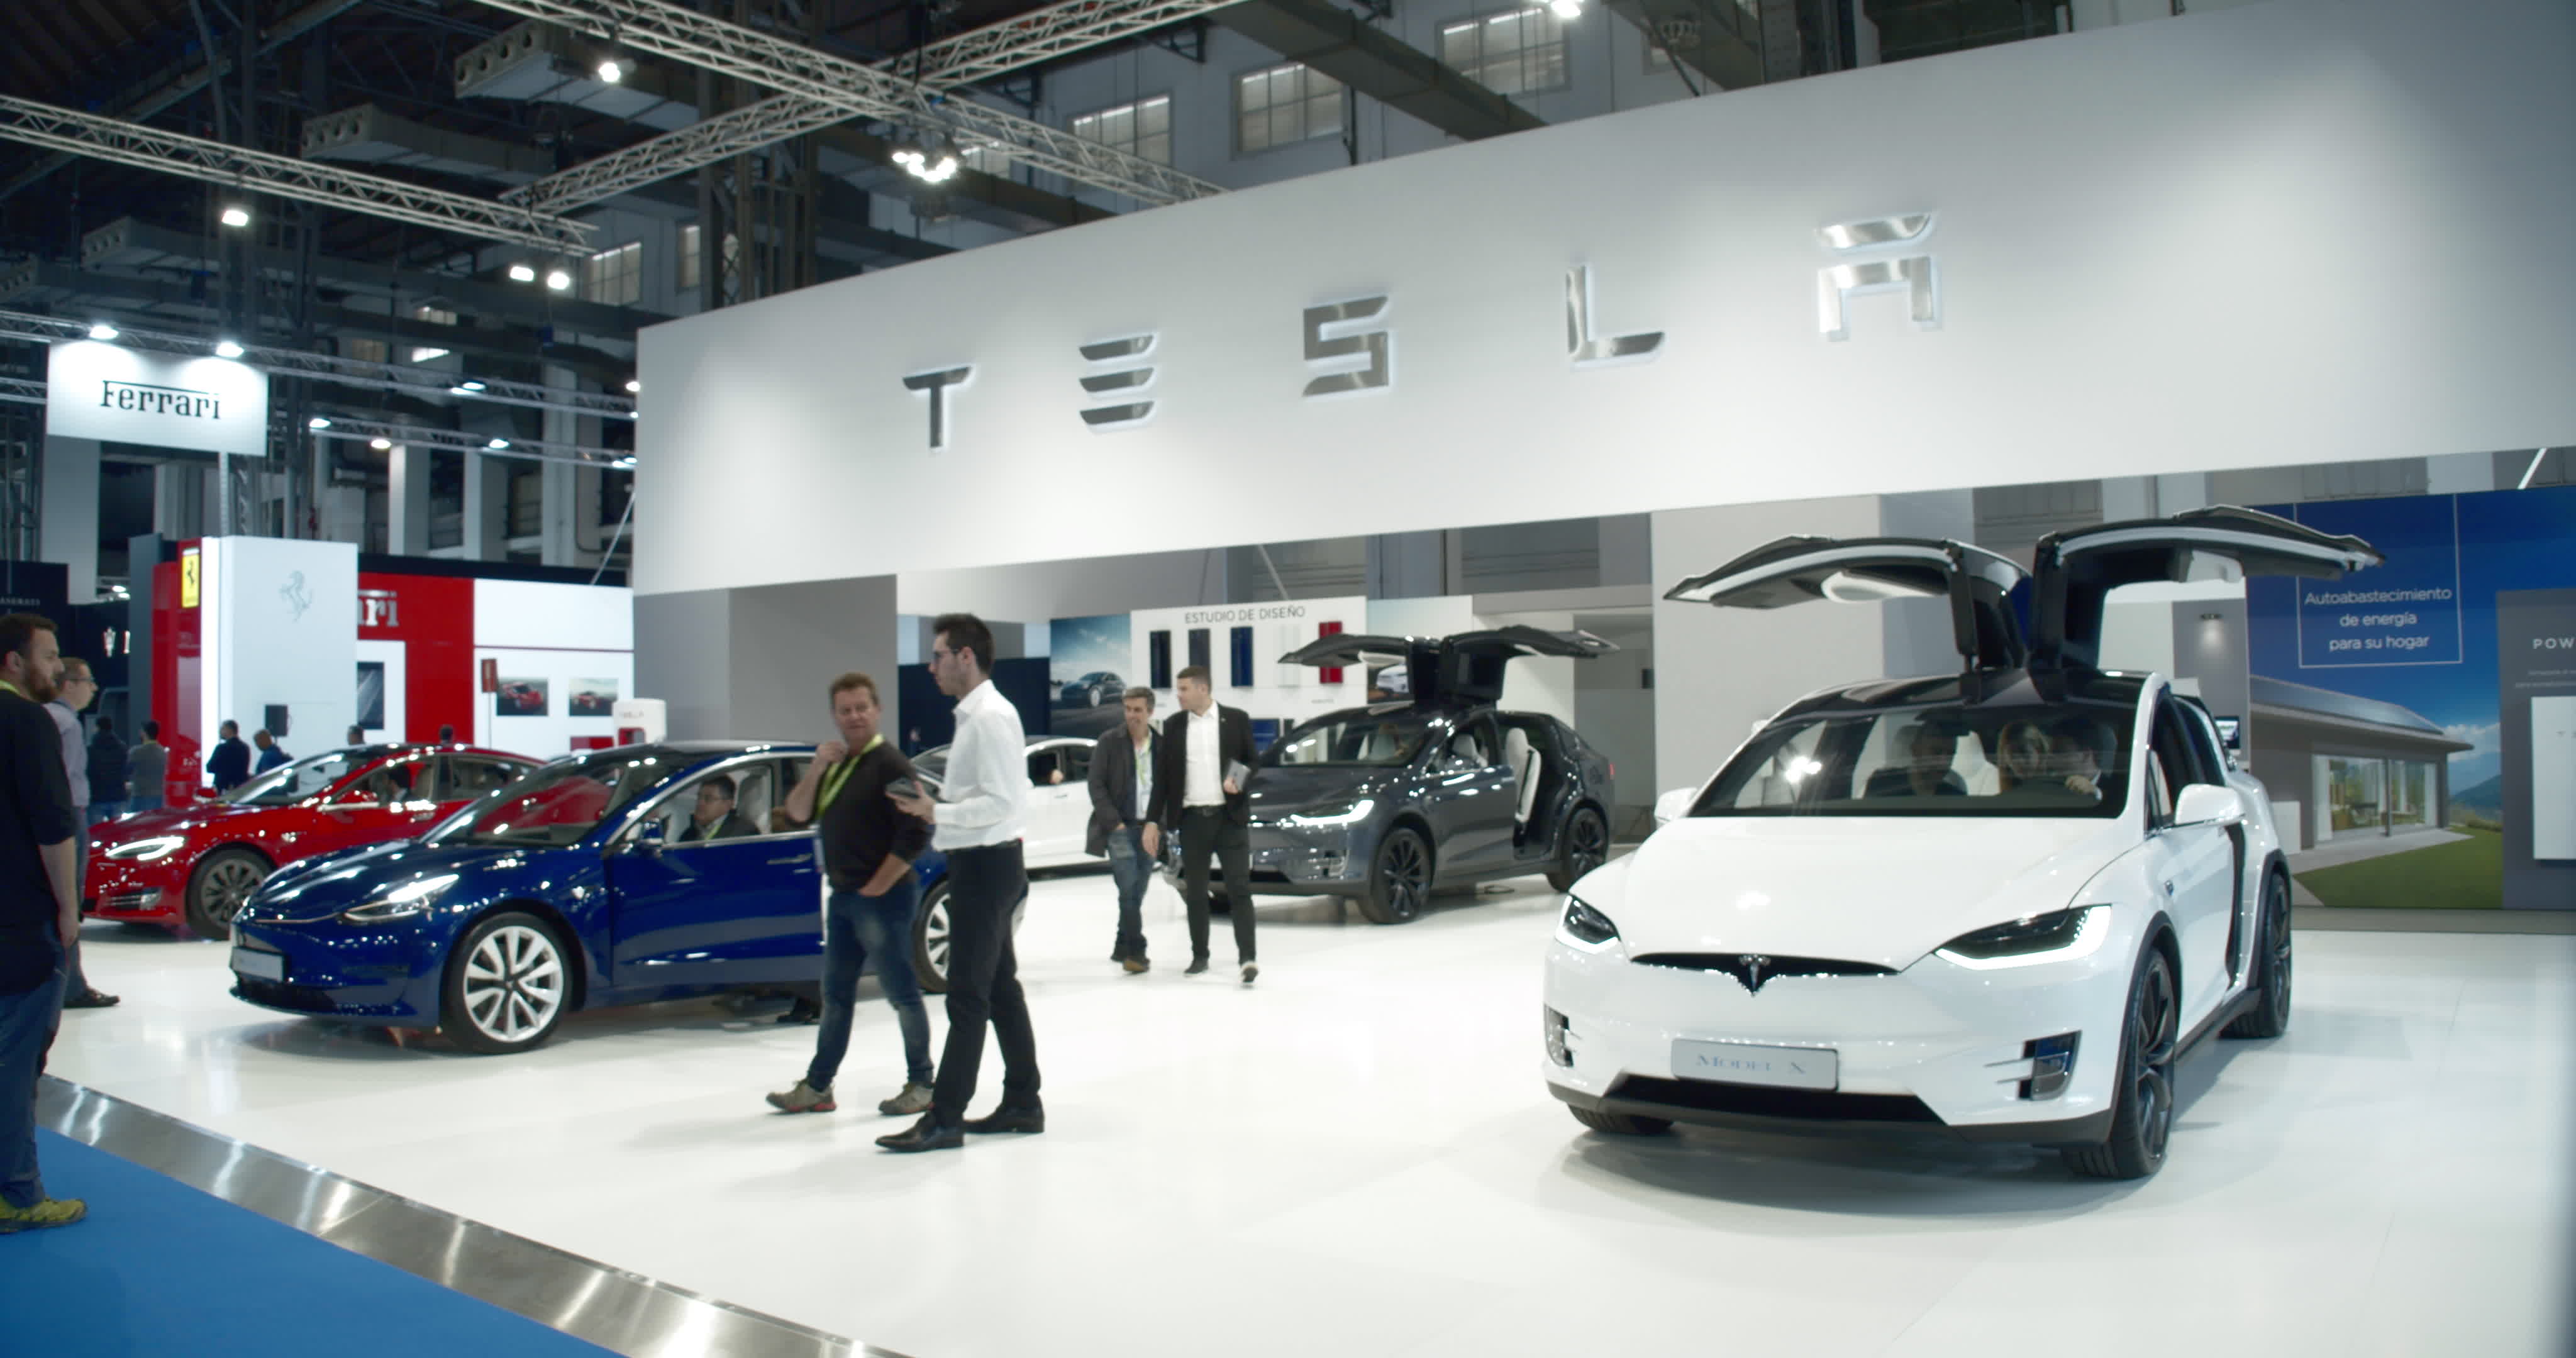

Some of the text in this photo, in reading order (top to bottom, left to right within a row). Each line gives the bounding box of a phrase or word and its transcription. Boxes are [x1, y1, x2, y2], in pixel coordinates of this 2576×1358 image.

[902, 213, 1936, 448] TESLA
[100, 380, 220, 419] Ferrari
[2304, 588, 2452, 605] Autoabastecimiento
[1185, 604, 1305, 624] ESTUDIO DE DISEÑO
[2340, 611, 2417, 627] de energía
[2329, 635, 2429, 651] para su hogar
